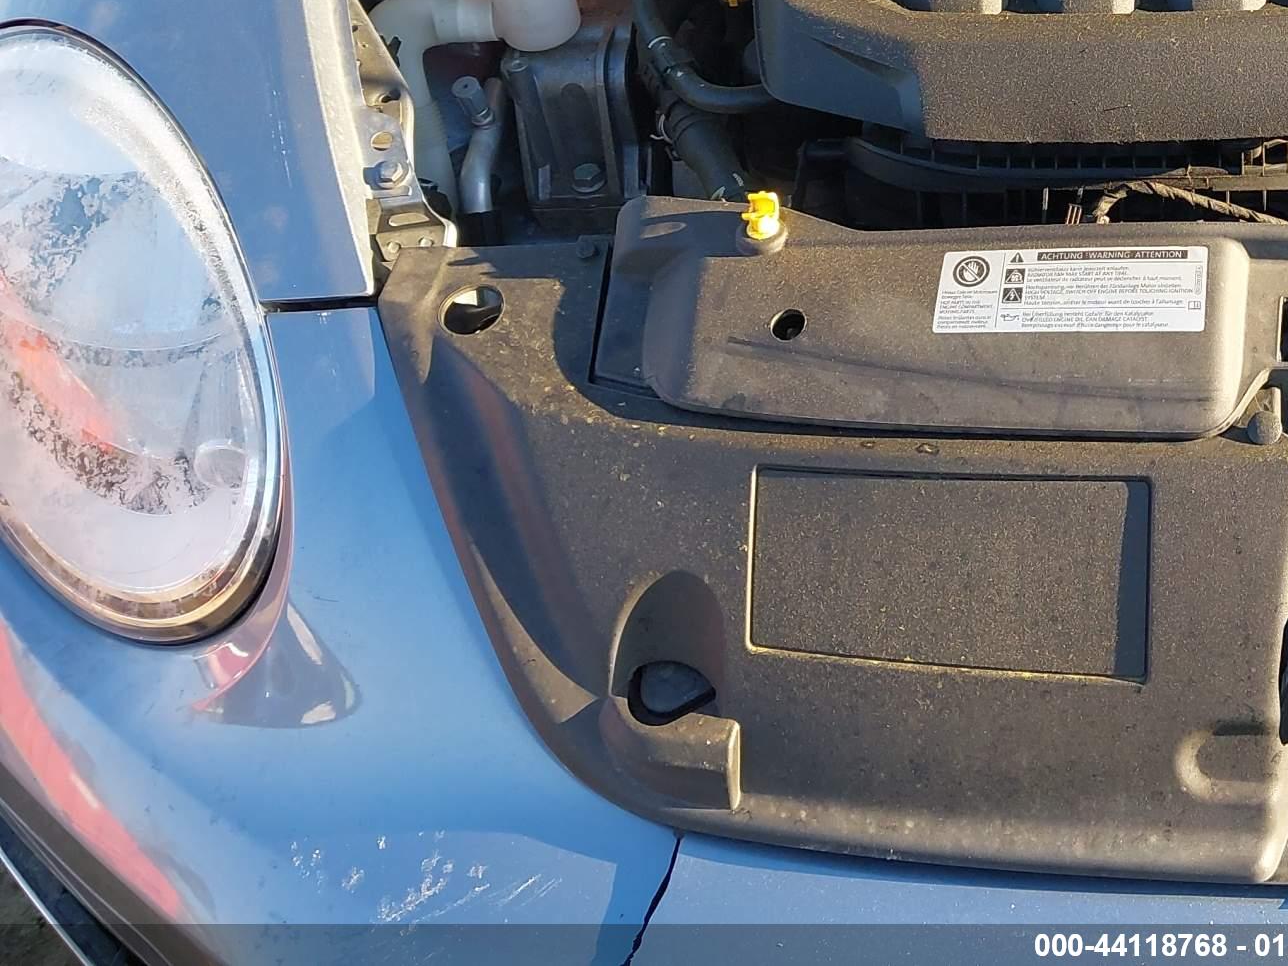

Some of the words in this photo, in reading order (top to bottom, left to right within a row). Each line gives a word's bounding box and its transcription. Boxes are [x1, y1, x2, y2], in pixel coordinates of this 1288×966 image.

[1041, 252, 1083, 260] ACHTUNG
[1089, 251, 1130, 259] WARNING
[1135, 250, 1182, 259] ATTENTION
